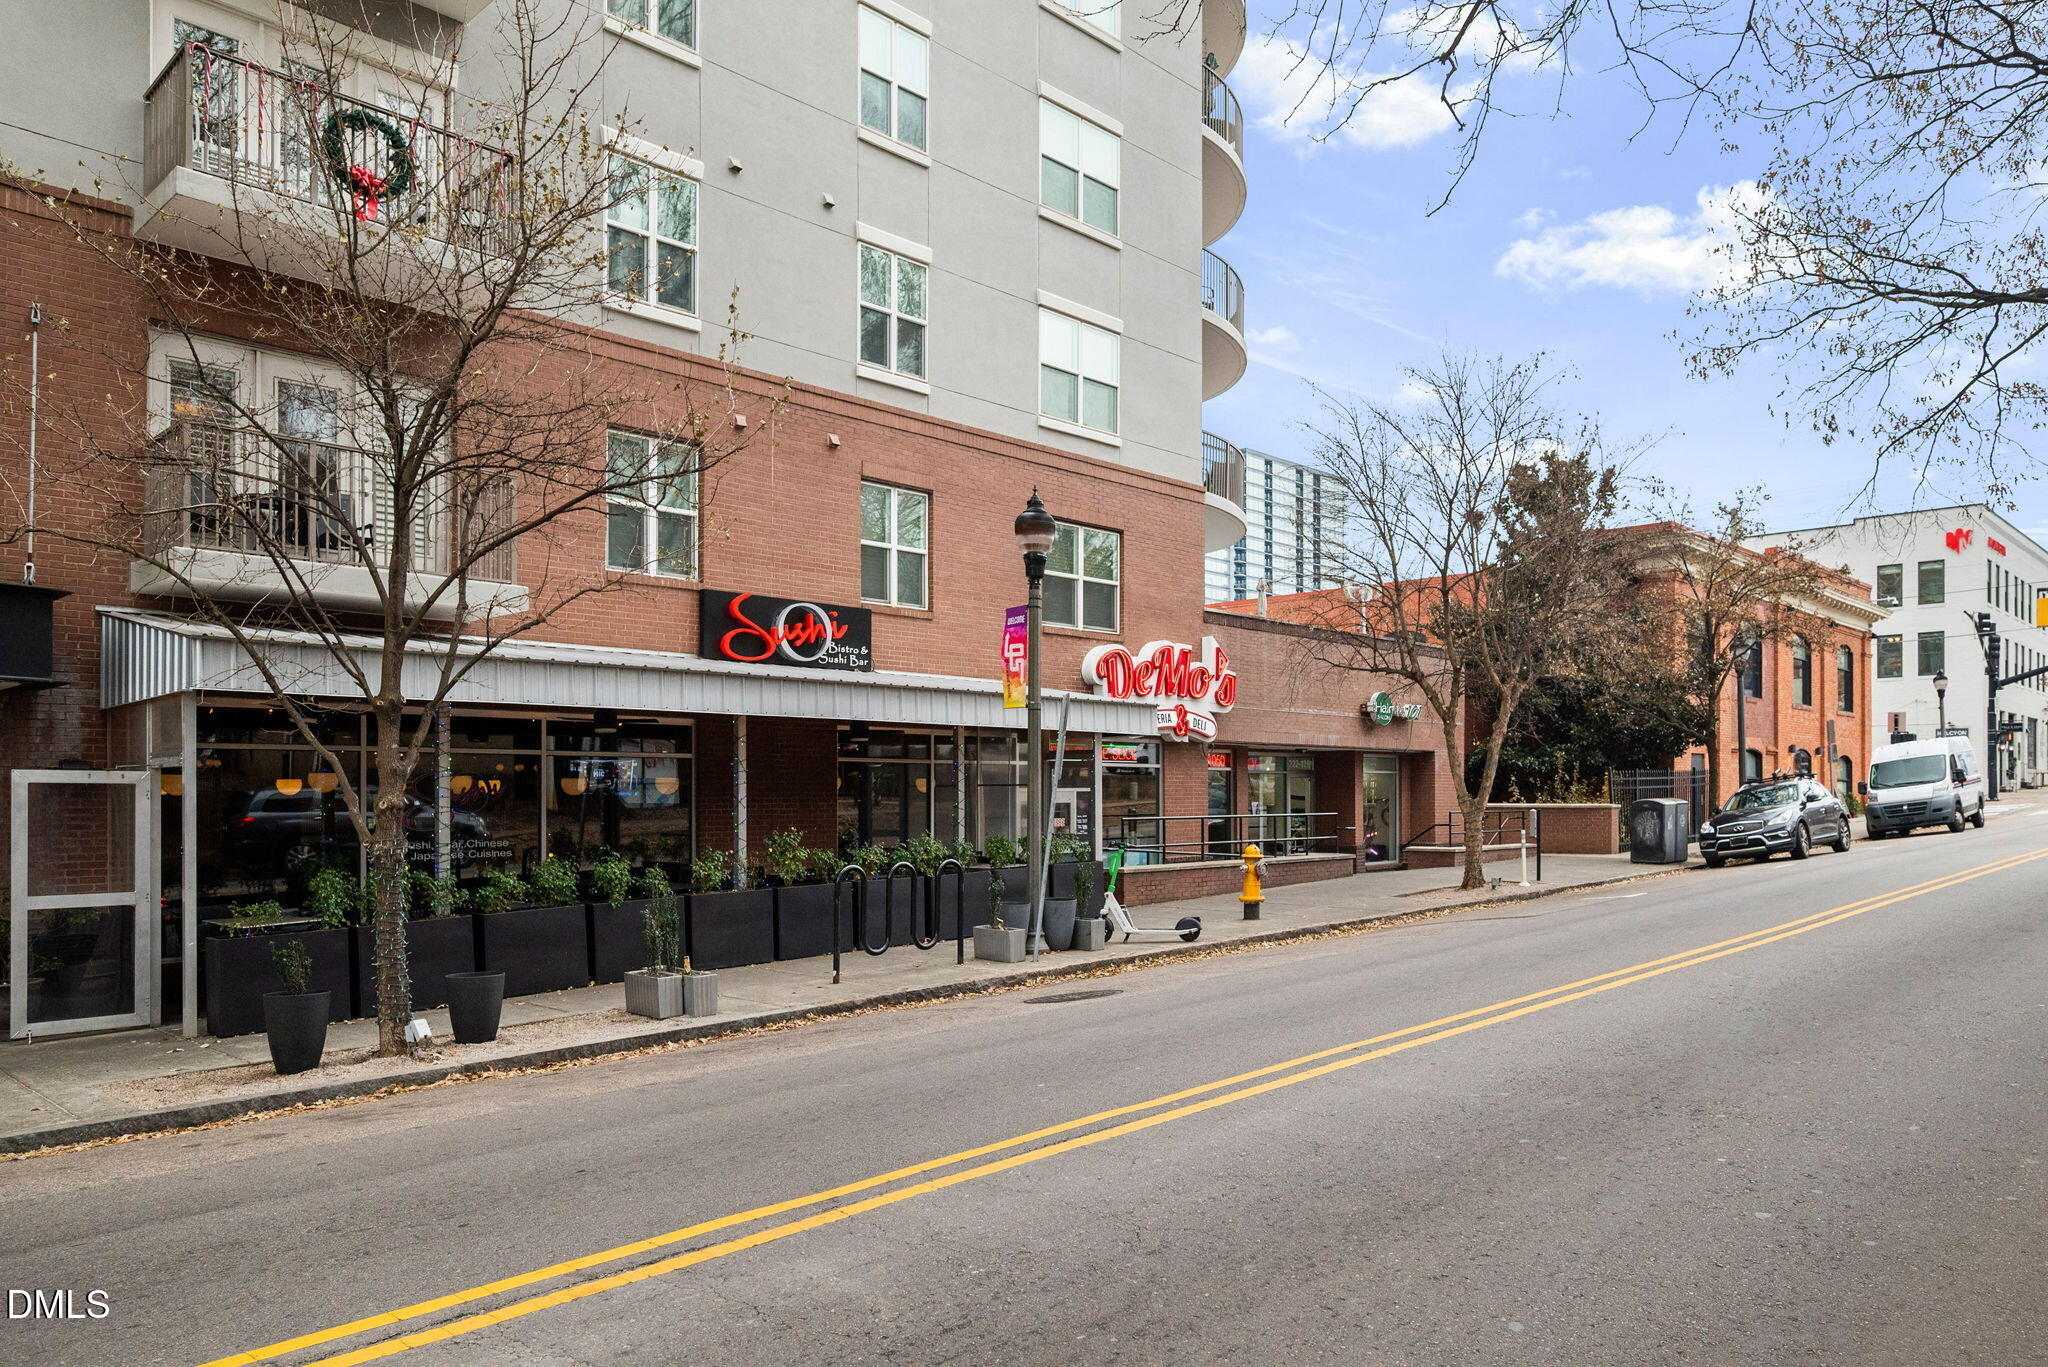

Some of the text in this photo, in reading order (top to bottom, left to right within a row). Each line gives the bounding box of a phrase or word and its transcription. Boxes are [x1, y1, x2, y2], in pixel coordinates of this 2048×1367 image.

[719, 593, 849, 661] Sushi
[829, 642, 869, 655] Bistro &
[818, 652, 869, 667] Sushi Bar
[1096, 644, 1237, 708] DeMo's
[1174, 704, 1190, 736] &
[1192, 717, 1207, 731] DELI
[466, 839, 509, 849] Chinese
[468, 849, 512, 859] Cuisines
